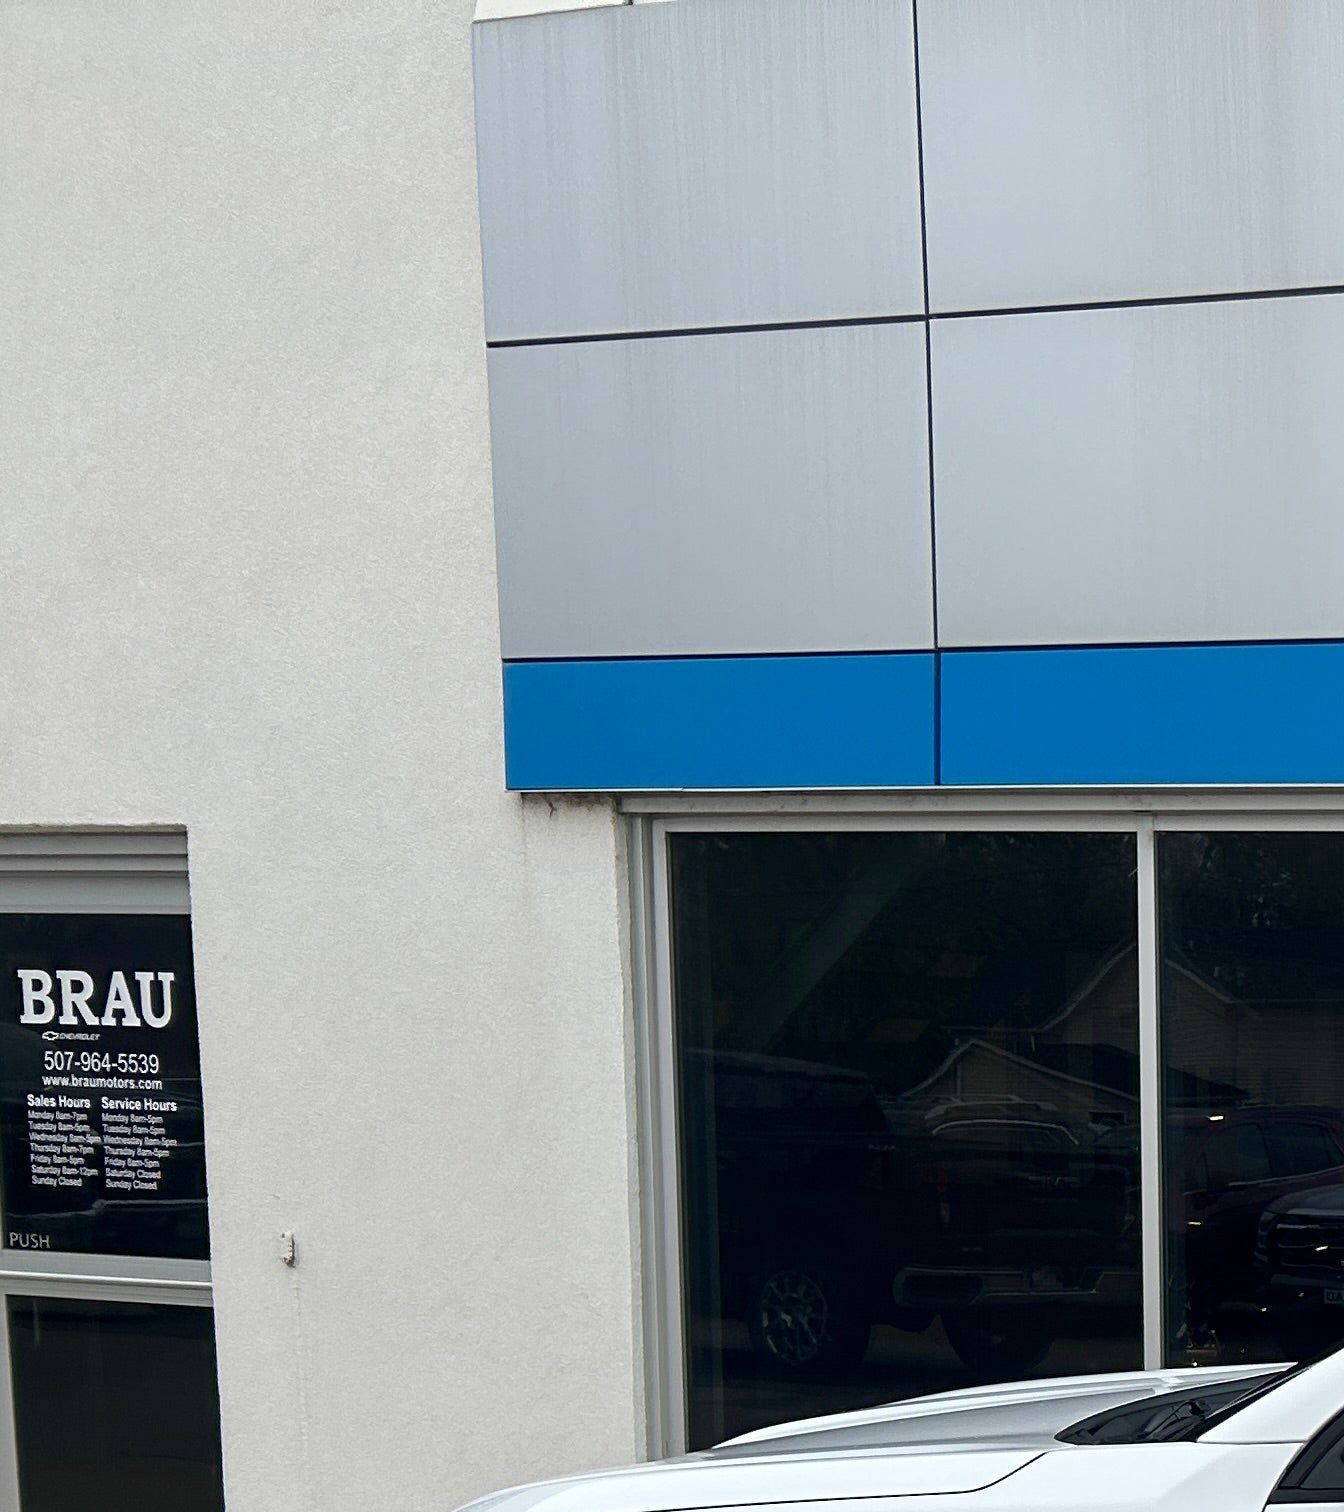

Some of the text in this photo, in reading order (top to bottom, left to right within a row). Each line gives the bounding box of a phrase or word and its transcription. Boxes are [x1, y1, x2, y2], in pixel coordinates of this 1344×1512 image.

[17, 969, 174, 1028] BRAU
[58, 1033, 100, 1041] CHEVROLET
[44, 1051, 160, 1074] 507-964-5539
[42, 1074, 163, 1090] www.braumotors.com
[27, 1094, 91, 1108] Sales Hours
[101, 1097, 177, 1111] Service Hours
[28, 1110, 54, 1121] Monday
[9, 1231, 50, 1249] PUSH
